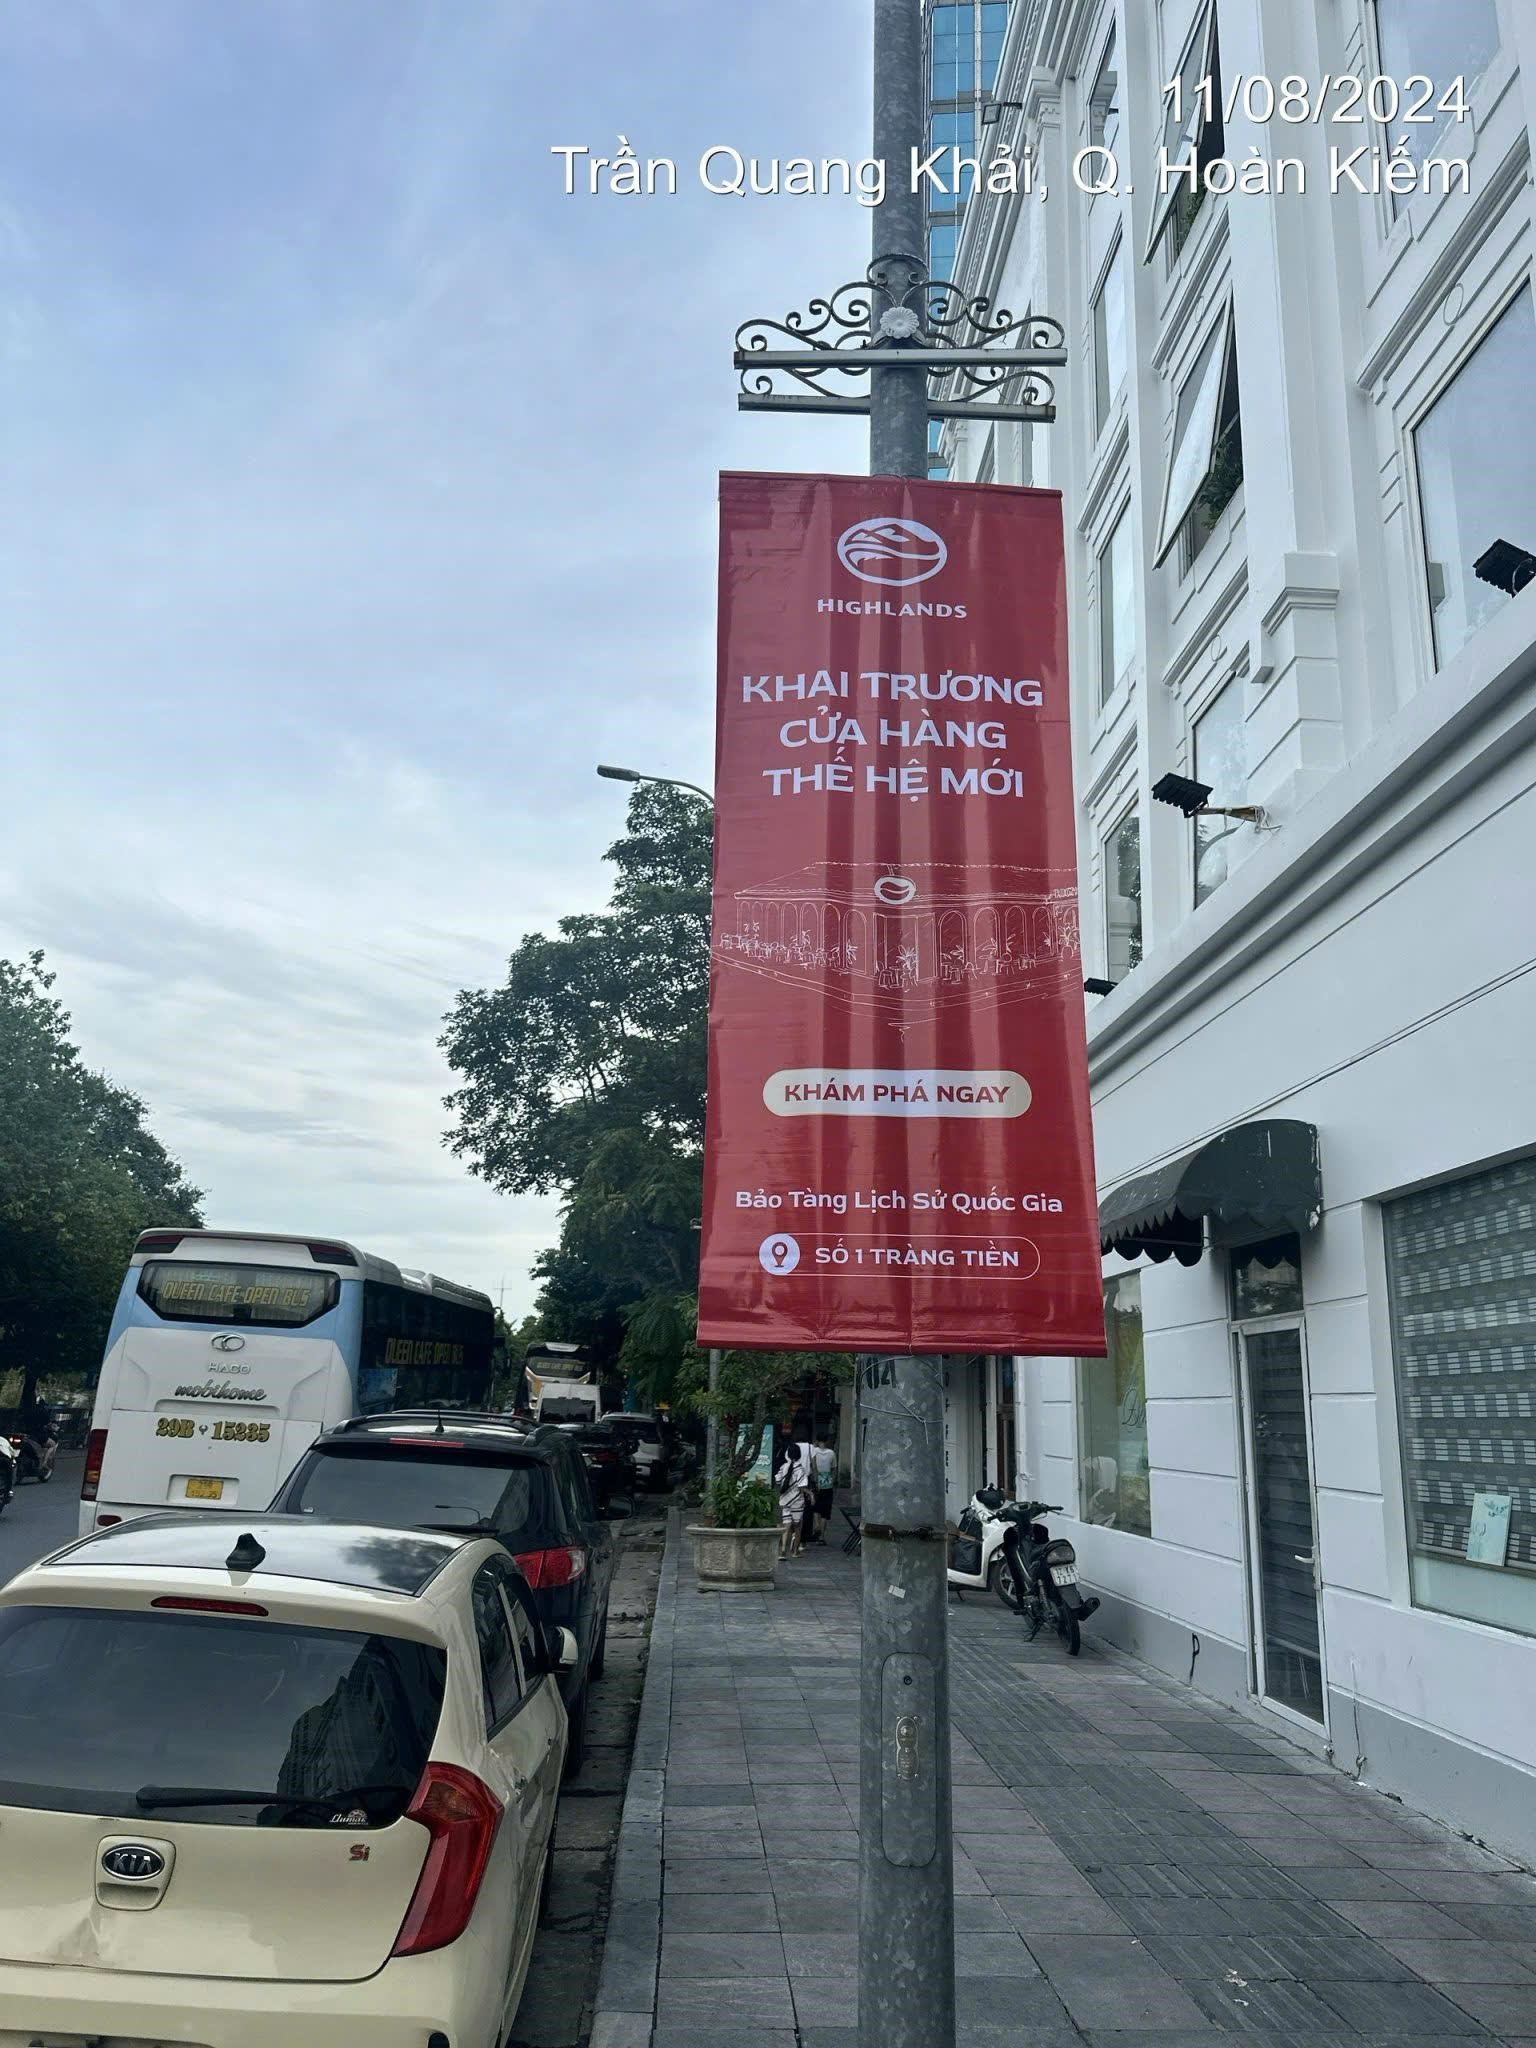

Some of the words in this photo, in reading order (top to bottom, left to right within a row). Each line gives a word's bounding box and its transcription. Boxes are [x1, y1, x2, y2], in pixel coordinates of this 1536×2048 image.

[817, 598, 968, 619] HIGHLANDS
[742, 670, 849, 703] KHAI
[860, 669, 1044, 708] TRƯƠNG
[779, 704, 868, 748] CỬA
[879, 708, 1008, 750] HÀNG
[762, 747, 854, 796] THẾ
[866, 758, 929, 802] HỆ
[941, 757, 1025, 798] MỚI
[784, 1078, 865, 1102] KHÁM
[873, 1079, 929, 1103] PHÁ
[936, 1085, 1010, 1104] NGAY
[735, 1188, 783, 1209] Bảo
[788, 1187, 847, 1214] Tàng
[854, 1189, 906, 1214] Lịch
[912, 1188, 948, 1210] Sử
[951, 1185, 1016, 1215] Quốc
[1021, 1192, 1063, 1213] Gia
[815, 1237, 849, 1264] SỐ
[855, 1248, 864, 1264] 1
[870, 1238, 955, 1267] TRÀNG
[961, 1240, 1019, 1268] TIỀN
[162, 1280, 205, 1301] QUEEN
[207, 1283, 241, 1303] CAFE
[243, 1285, 280, 1304] OPEN
[284, 1287, 312, 1307] BUS
[173, 1379, 268, 1401] mobihome
[155, 1417, 196, 1439] 29B
[210, 1420, 272, 1443] 15235
[112, 1852, 153, 1873] KIA
[348, 1844, 371, 1862] Si
